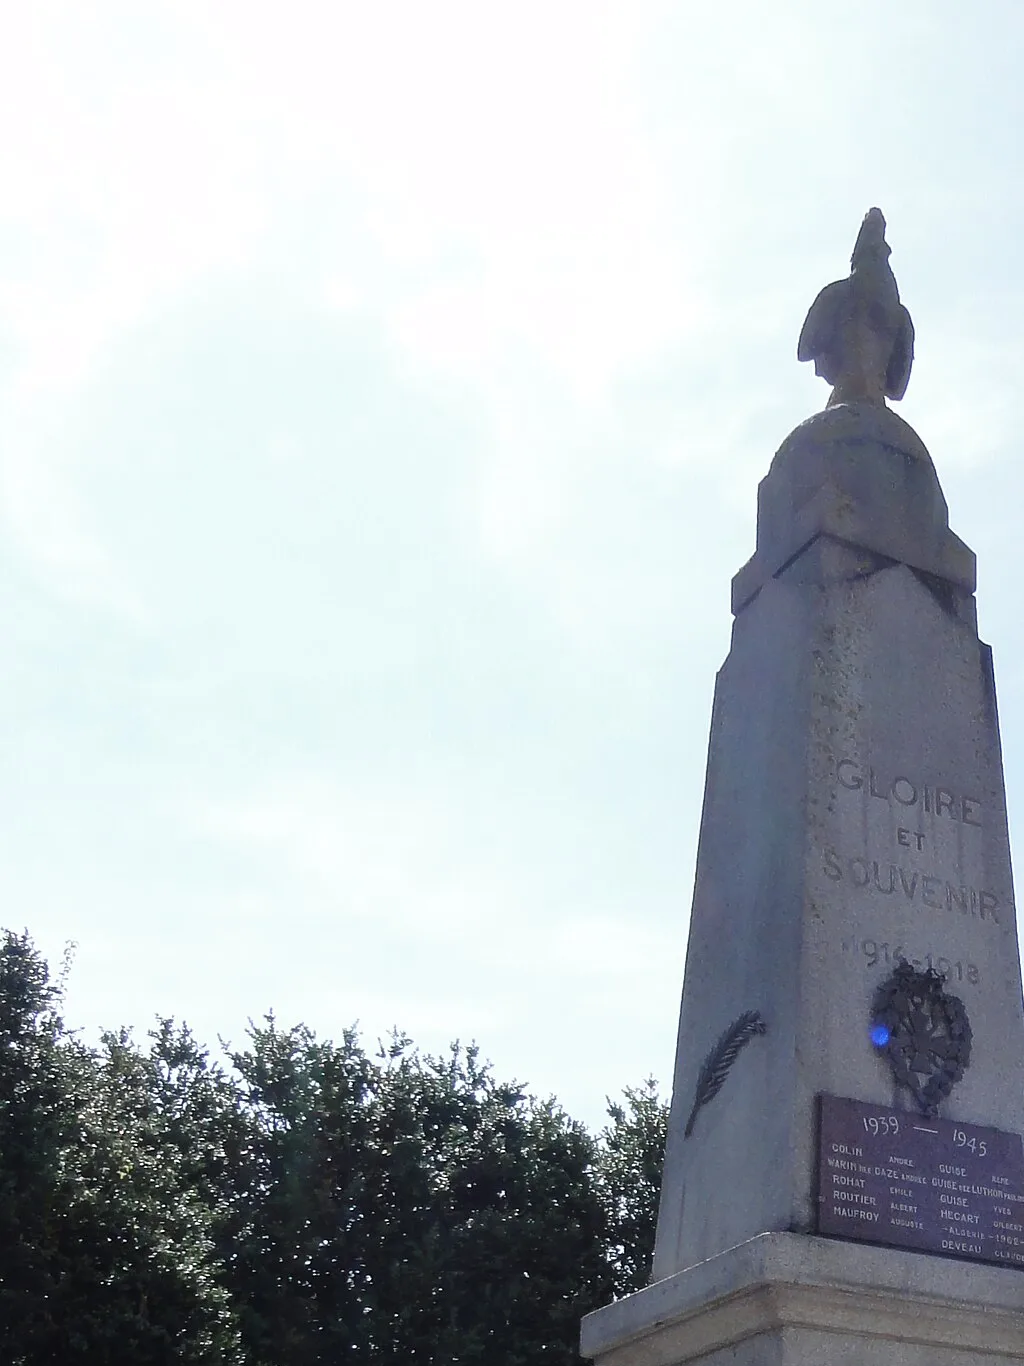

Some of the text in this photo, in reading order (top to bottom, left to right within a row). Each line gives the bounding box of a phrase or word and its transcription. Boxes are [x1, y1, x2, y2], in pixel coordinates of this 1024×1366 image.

[836, 759, 982, 827] GLOIRE
[897, 827, 925, 851] ET
[823, 849, 1000, 924] SOUVENIR
[863, 1116, 899, 1137] 1939
[953, 1129, 988, 1157] 1945
[832, 1143, 863, 1157] COLIN
[827, 1158, 857, 1172] WARIN
[939, 1164, 967, 1177] GUISE
[832, 1174, 866, 1188] ROHAT
[931, 1177, 957, 1190] GUISE
[833, 1190, 877, 1206] ROUTIER
[940, 1194, 969, 1207] GUISE
[833, 1206, 879, 1222] MAUFROY
[940, 1209, 980, 1224] HECART
[941, 1240, 982, 1254] DEVEAU
